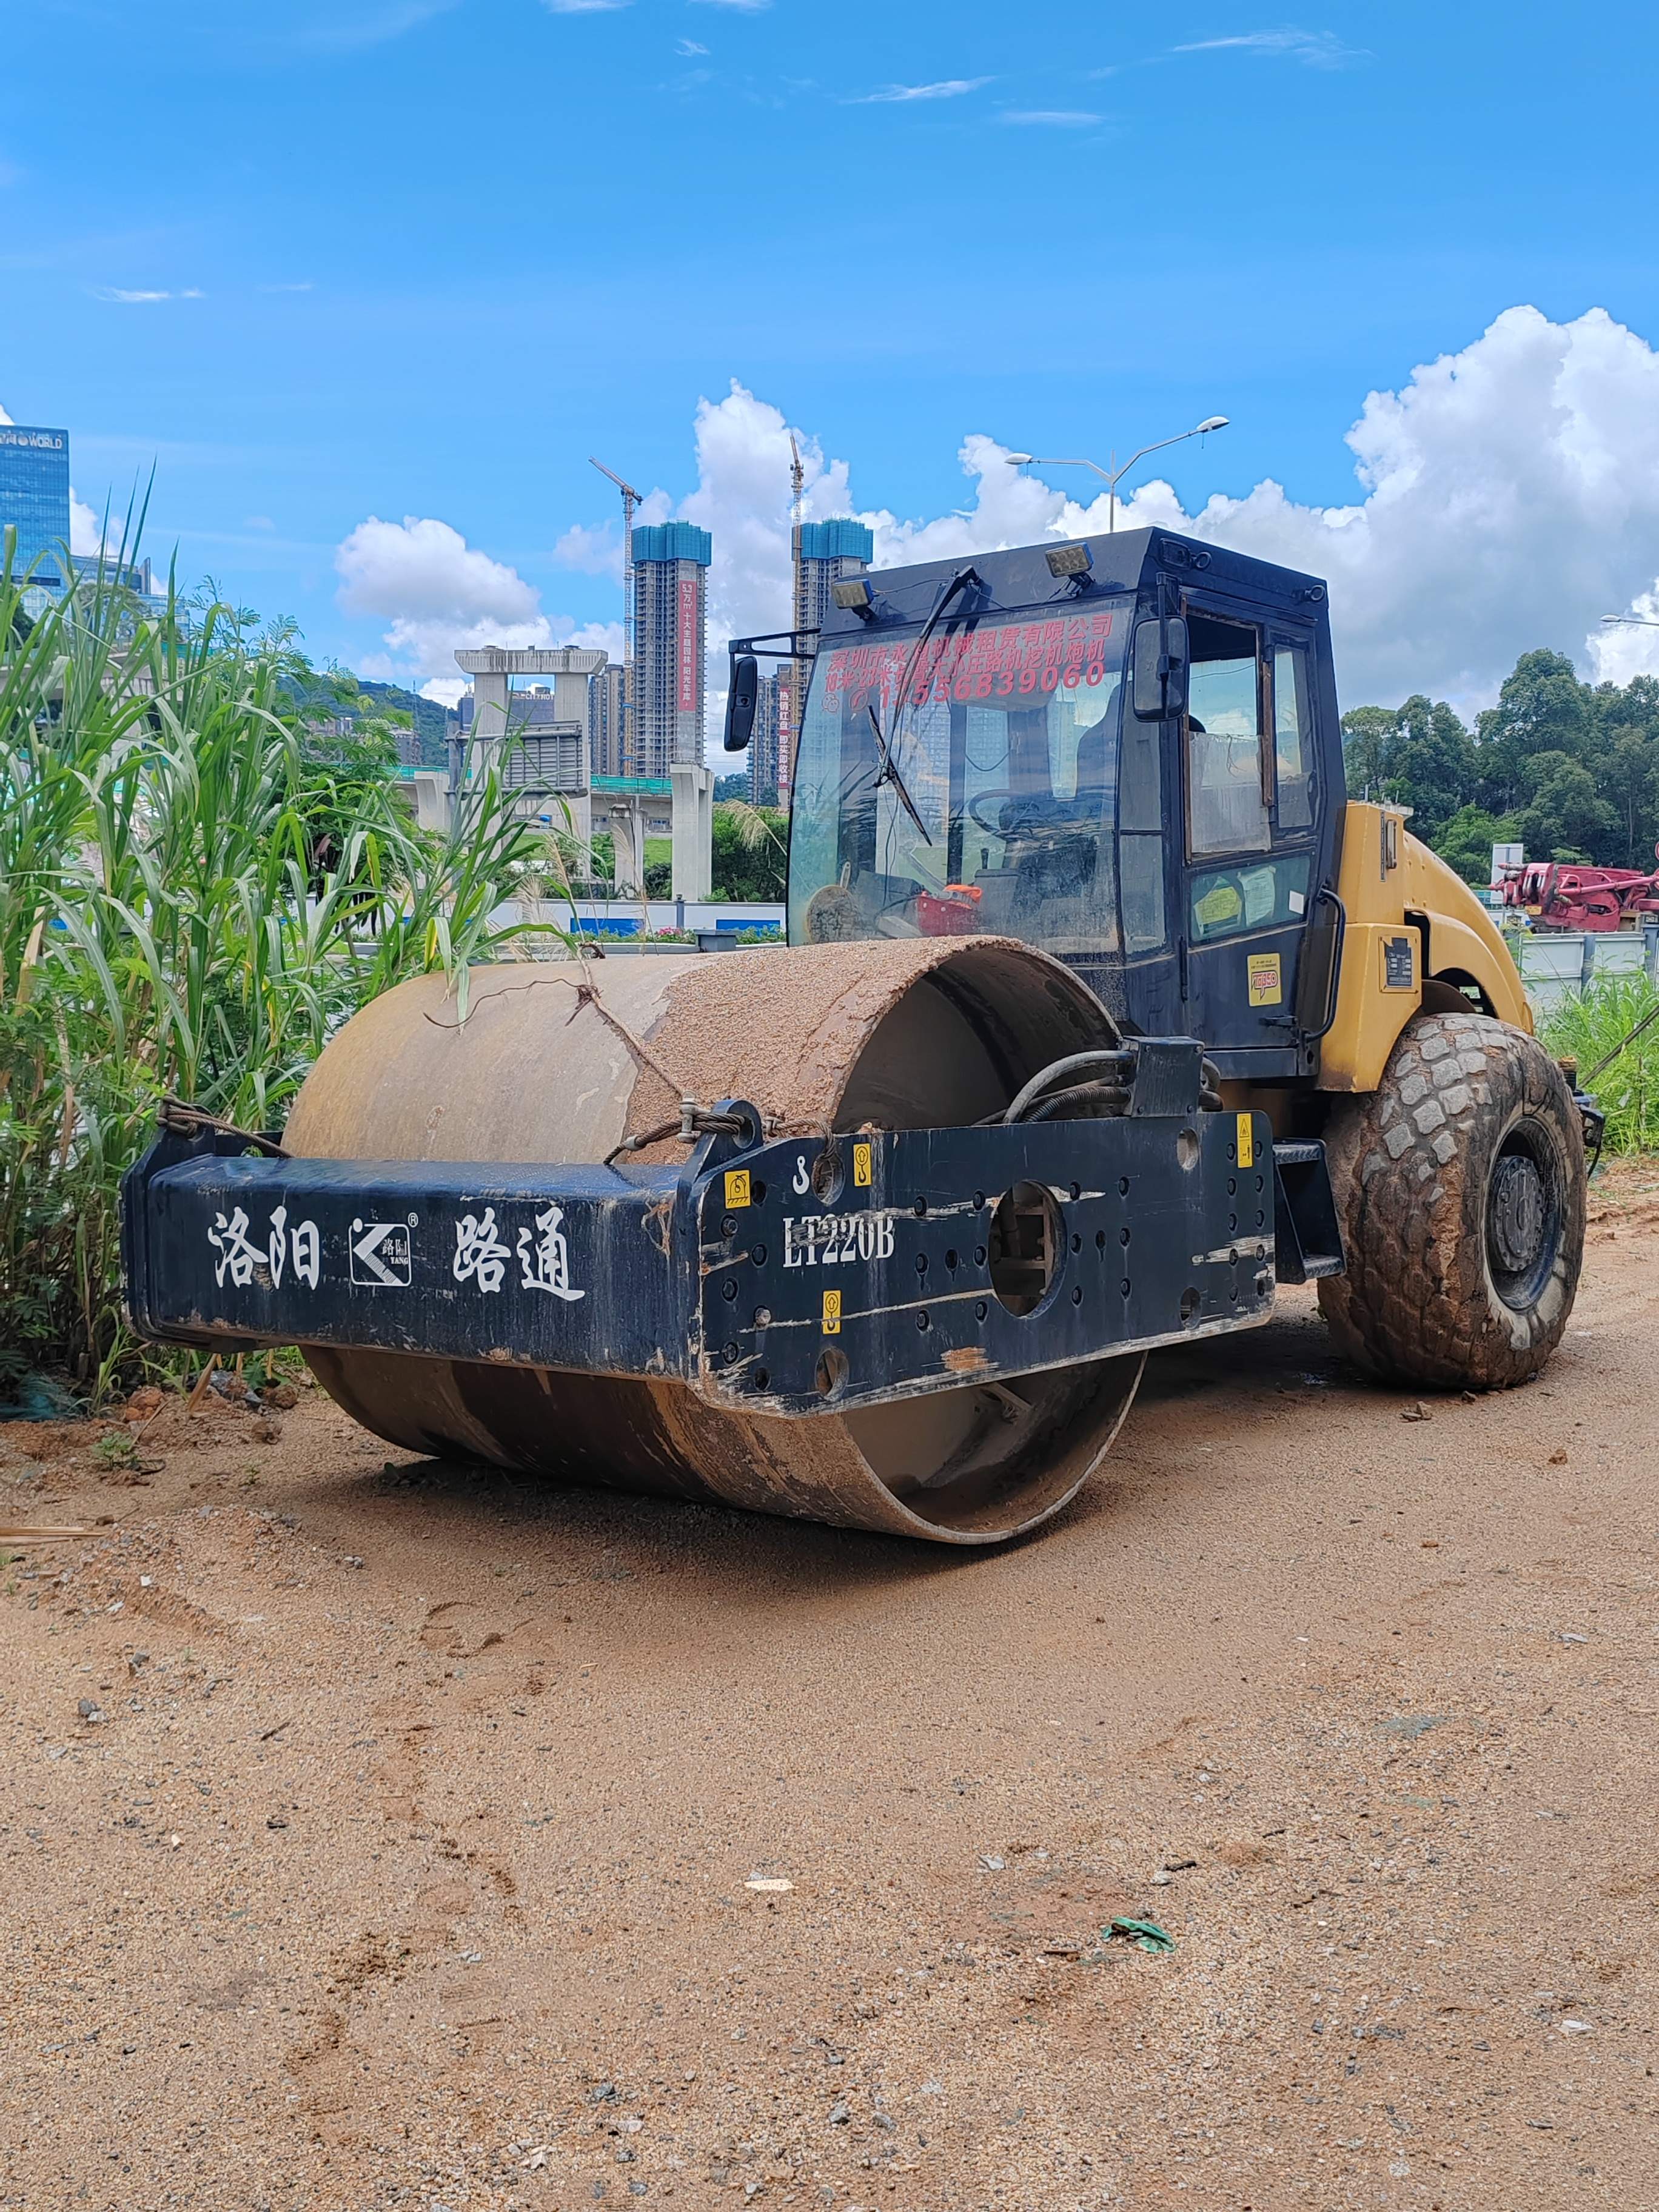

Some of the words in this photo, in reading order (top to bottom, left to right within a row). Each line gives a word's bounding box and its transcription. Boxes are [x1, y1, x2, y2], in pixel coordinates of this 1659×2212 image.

[28, 432, 62, 449] WORLD
[880, 662, 1105, 709] 1556839060
[207, 1206, 320, 1290] 洛阳
[452, 1206, 586, 1301] 路通
[783, 1213, 894, 1268] LT220B
